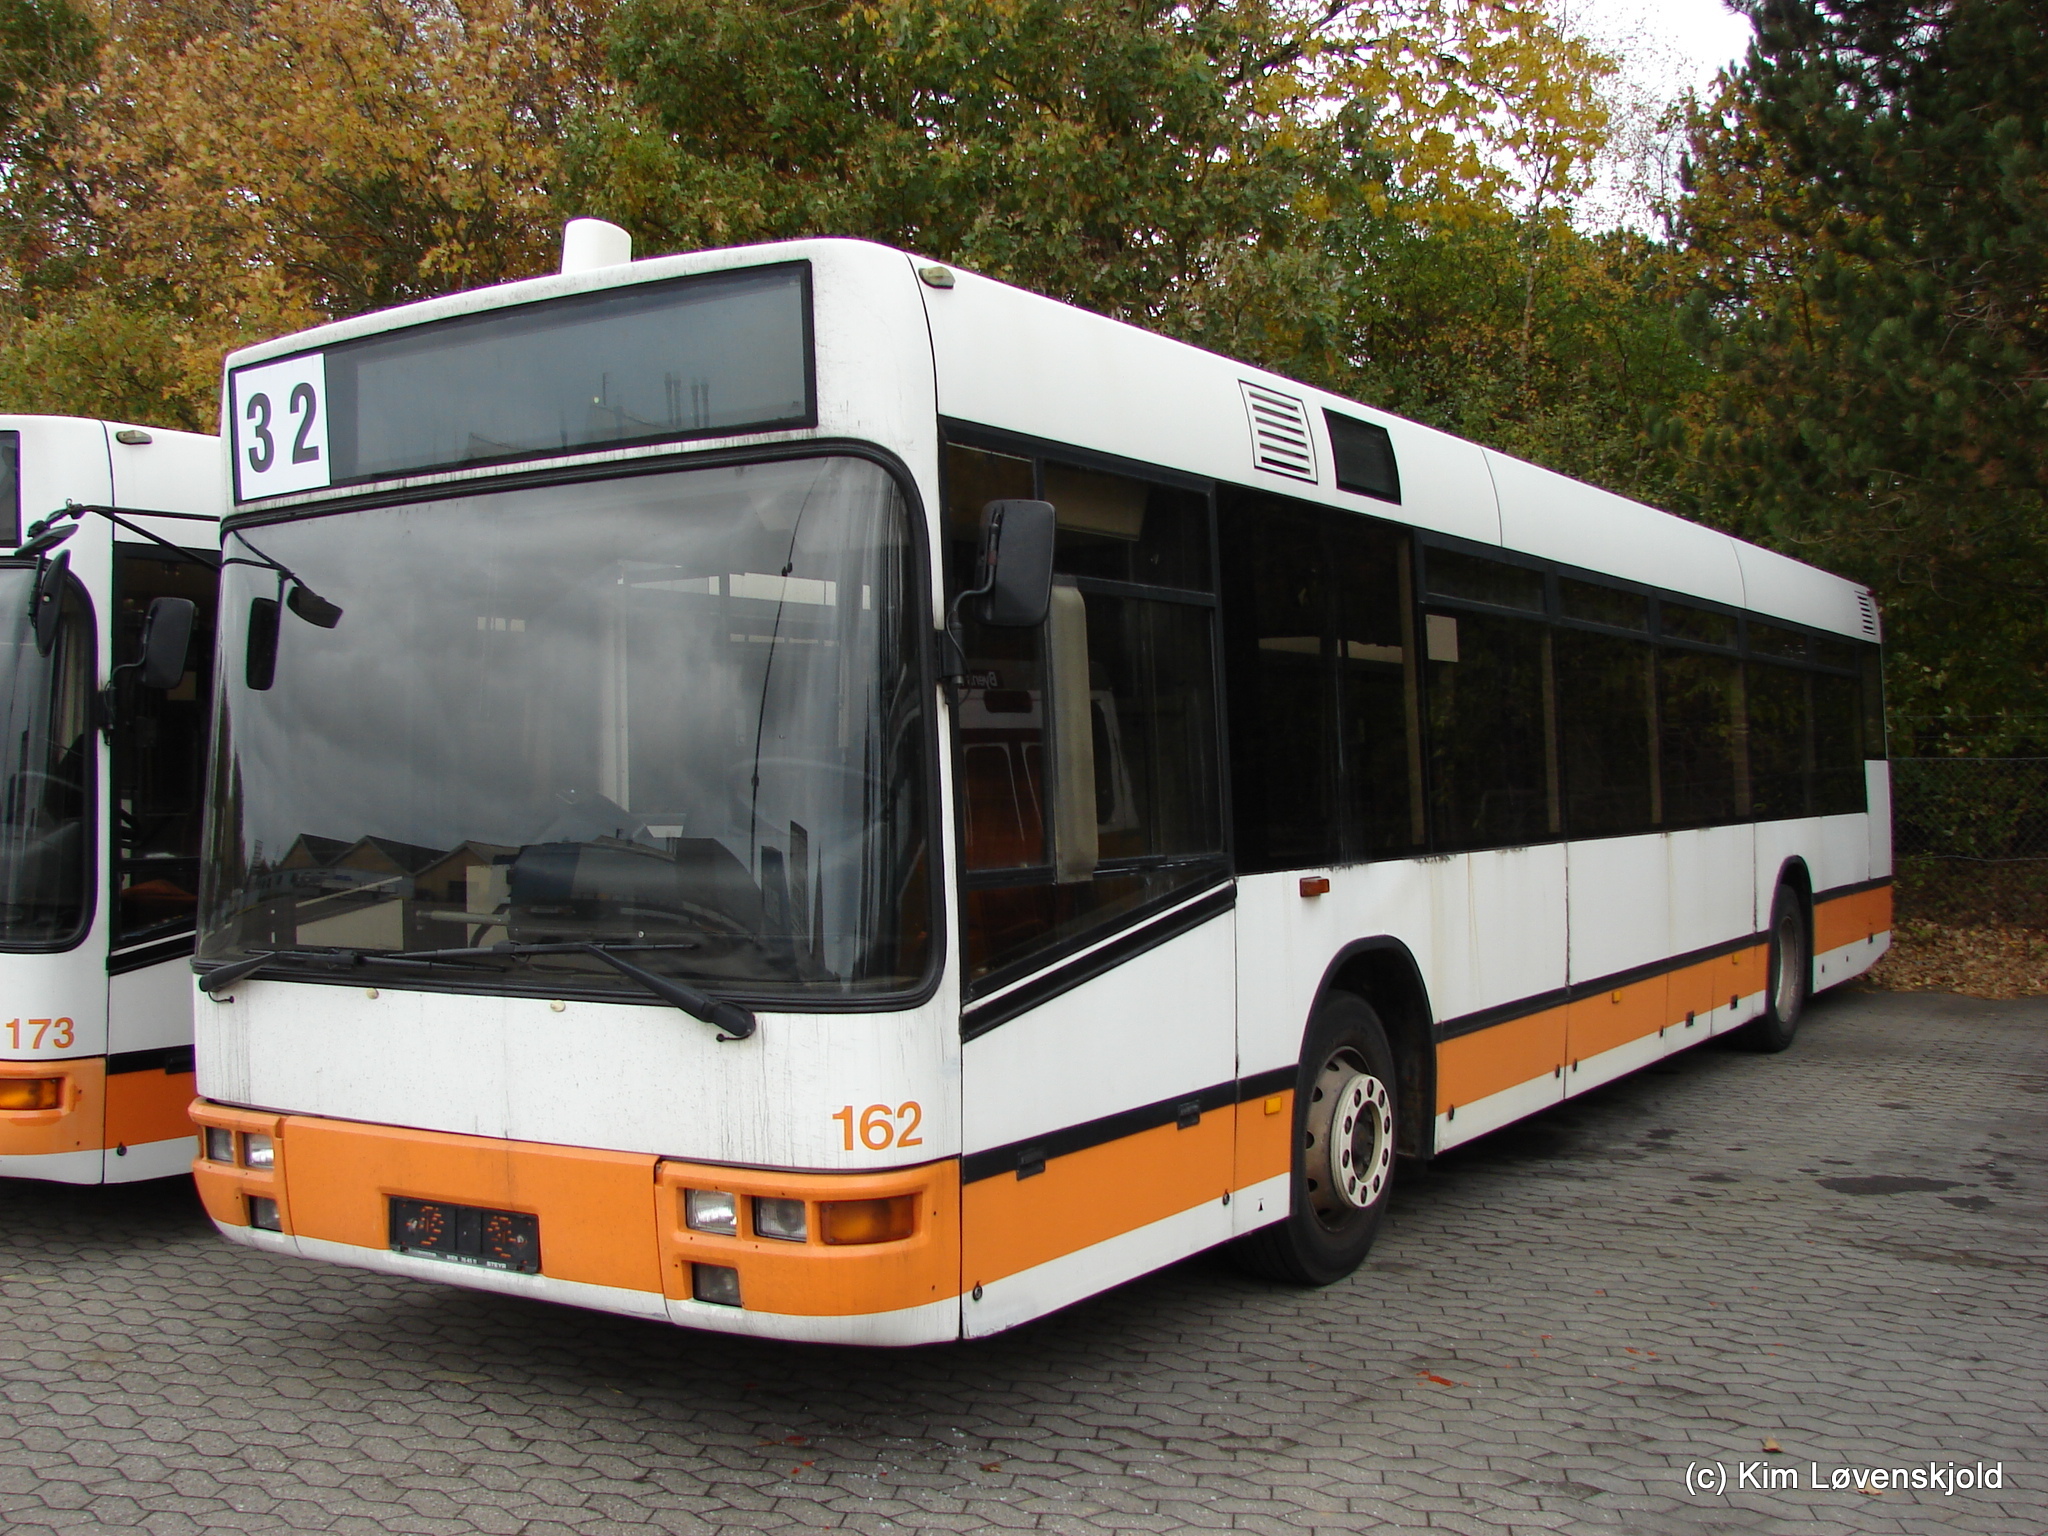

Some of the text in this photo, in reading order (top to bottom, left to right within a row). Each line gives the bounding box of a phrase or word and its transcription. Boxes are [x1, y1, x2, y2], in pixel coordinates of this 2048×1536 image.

[247, 382, 320, 473] 32
[5, 1016, 75, 1050] 173
[832, 1100, 923, 1151] 162
